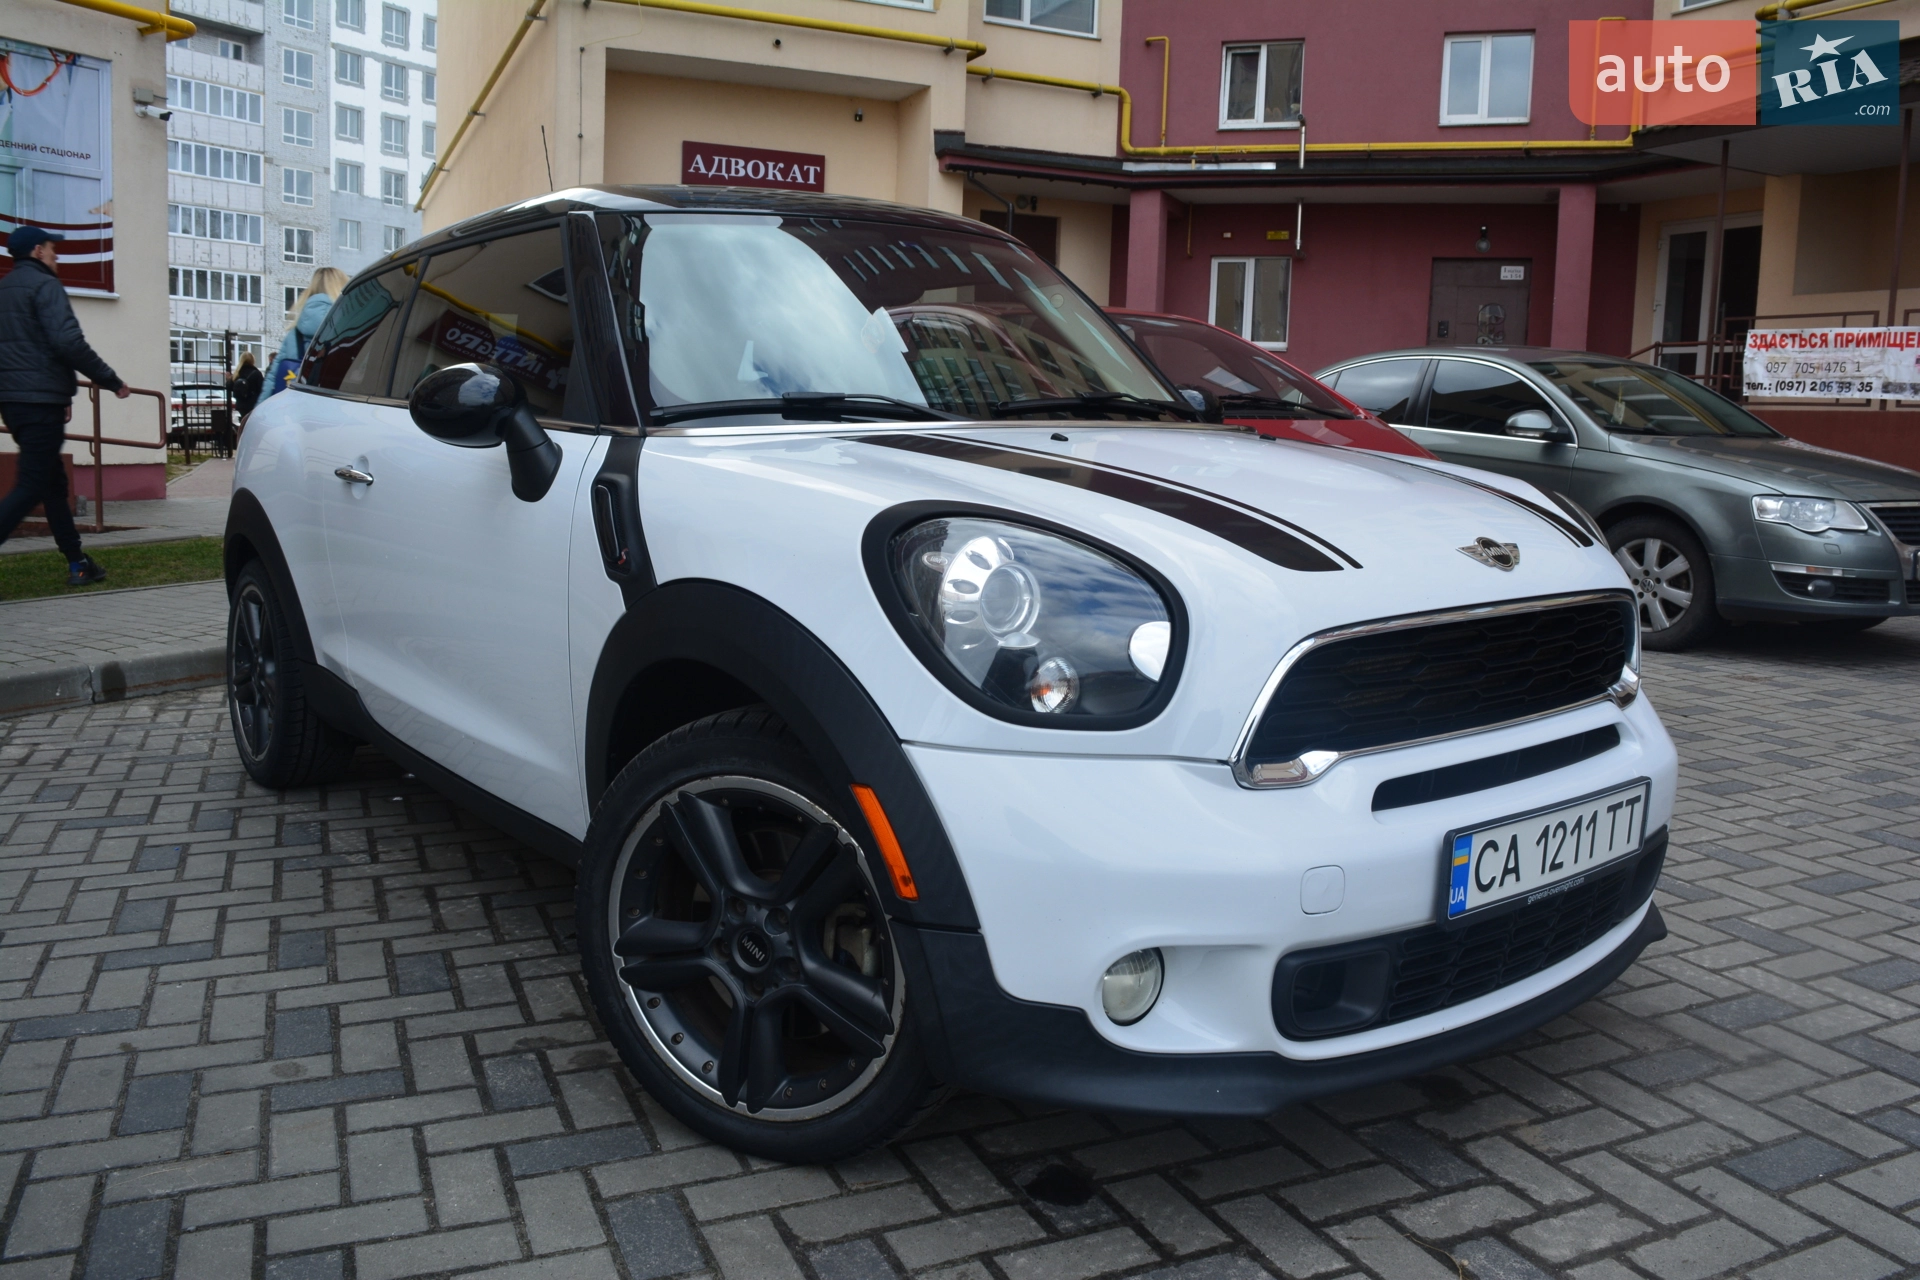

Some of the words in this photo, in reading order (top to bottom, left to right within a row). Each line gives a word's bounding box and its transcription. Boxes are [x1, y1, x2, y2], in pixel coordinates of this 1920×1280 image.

[39, 145, 91, 160] СТАЦІОНАР
[688, 153, 821, 185] АДВОКАТ
[1749, 333, 1829, 351] ЗДАЄТЬСЯ
[1834, 331, 1920, 351] ПРИМІЩЕ
[1766, 361, 1787, 374] 097
[1795, 362, 1816, 374] 705
[1824, 361, 1847, 374] 476
[1855, 361, 1861, 373] 1
[1775, 380, 1806, 393] (097)
[1857, 381, 1873, 392] 35
[1474, 833, 1521, 893] CA
[1535, 810, 1598, 875] 1211
[1607, 794, 1642, 852] TT
[1450, 886, 1465, 905] UA
[741, 935, 766, 962] MINI
